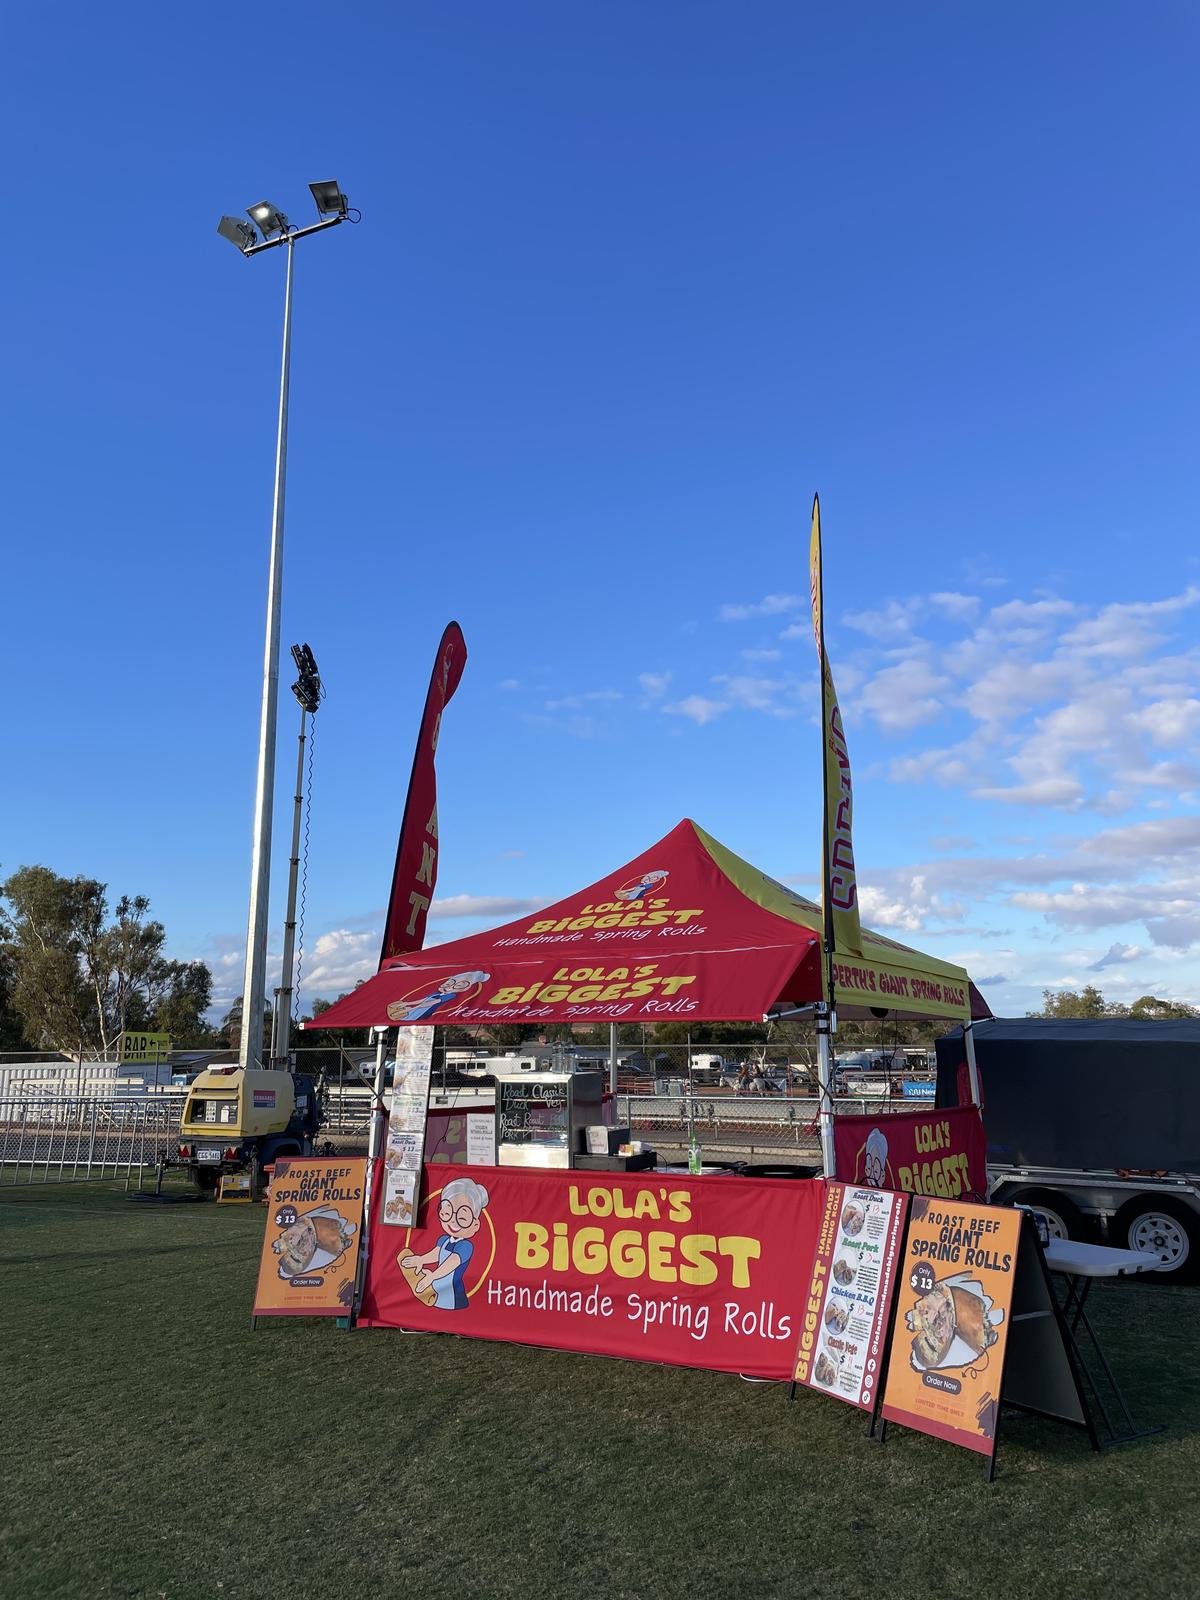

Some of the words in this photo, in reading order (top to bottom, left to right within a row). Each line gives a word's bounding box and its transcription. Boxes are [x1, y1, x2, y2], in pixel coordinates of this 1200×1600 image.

[580, 898, 670, 915] LOLA'S
[492, 932, 584, 947] Handmade
[590, 927, 652, 942] Spring
[657, 924, 708, 937] Rolls
[552, 964, 659, 981] LOLA'S
[448, 1005, 554, 1018] Handmade
[561, 1002, 633, 1018] Spring
[640, 998, 699, 1013] Rolls
[124, 1036, 147, 1059] BAR
[503, 1083, 529, 1099] Roast
[500, 1113, 522, 1129] Roast
[914, 1120, 951, 1153] LOLA'S
[290, 1170, 322, 1179] ROAST
[326, 1168, 351, 1178] BEEF
[300, 1177, 337, 1190] GIANT
[274, 1190, 319, 1202] SPRING
[323, 1188, 361, 1201] ROLLS
[852, 1192, 869, 1200] Roast
[869, 1194, 884, 1203] Duck
[569, 1185, 692, 1223] LOLA'S
[275, 1214, 282, 1225] $
[284, 1215, 296, 1224] 13
[818, 1186, 836, 1255] HANDMADE
[825, 1220, 836, 1257] SPRING
[831, 1186, 841, 1217] ROLLS
[928, 1212, 965, 1228] ROAST
[970, 1218, 1000, 1234] BEEF
[842, 1237, 861, 1250] Roast
[861, 1242, 879, 1253] Pork
[939, 1226, 983, 1249] GIANT
[911, 1239, 961, 1263] SPRING
[964, 1248, 1012, 1272] ROLLS
[918, 1267, 931, 1277] Only
[911, 1274, 918, 1288] $
[920, 1277, 933, 1290] 13
[831, 1286, 856, 1300] Chicken
[487, 1279, 614, 1317] Handmade
[627, 1293, 709, 1340] Spring
[724, 1301, 791, 1340] Rolls
[926, 1376, 943, 1386] Order
[943, 1381, 958, 1391] Now
